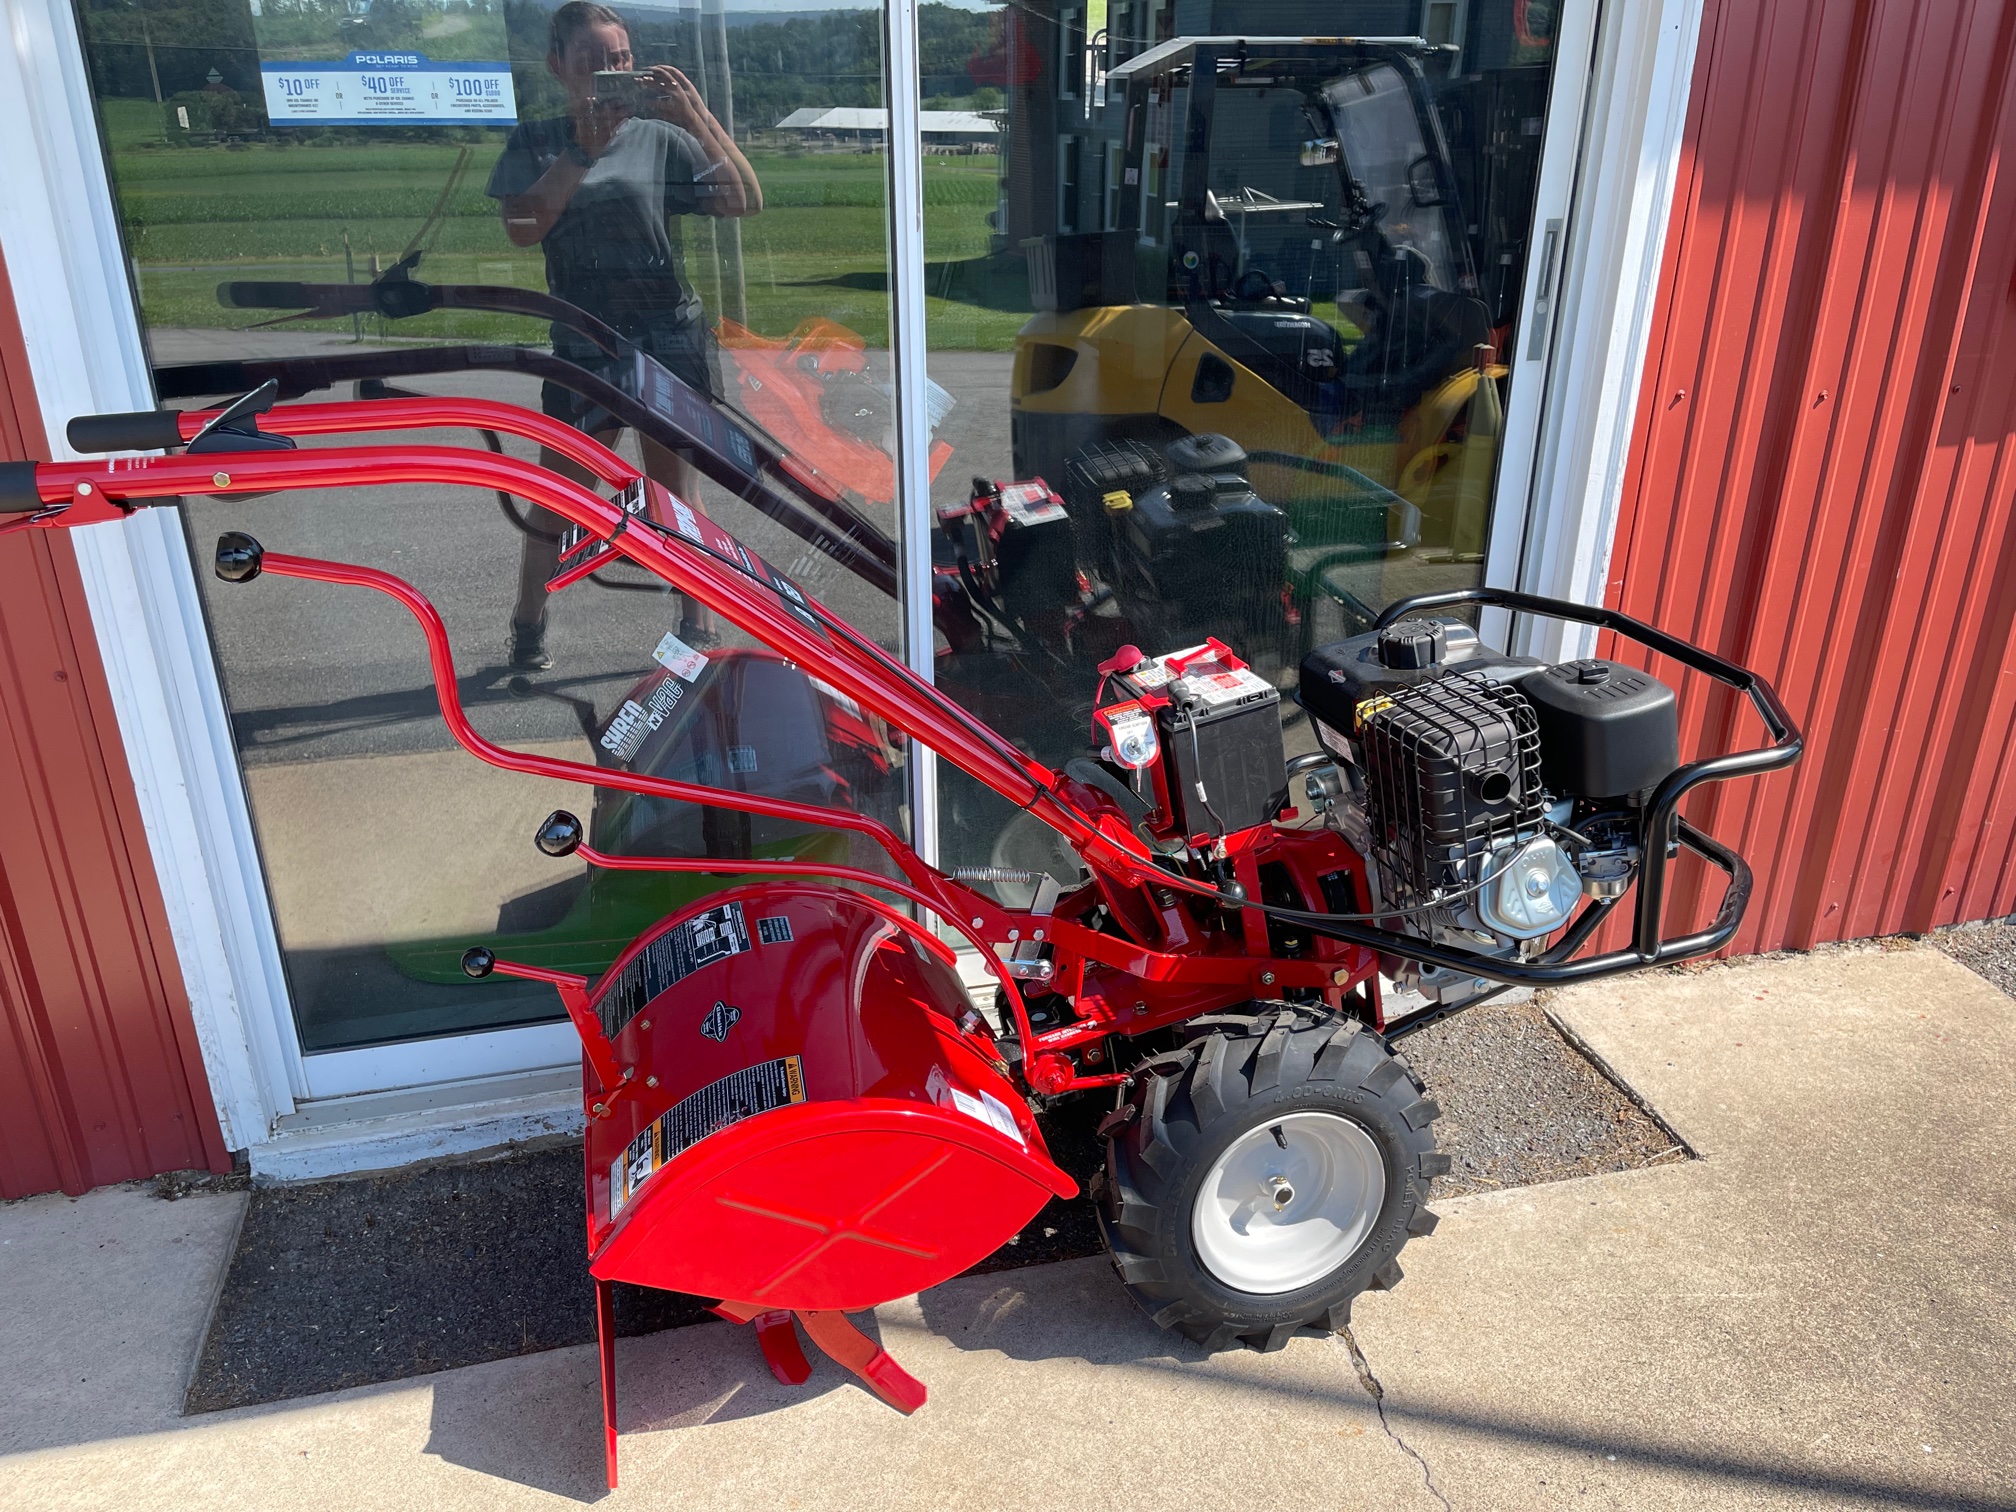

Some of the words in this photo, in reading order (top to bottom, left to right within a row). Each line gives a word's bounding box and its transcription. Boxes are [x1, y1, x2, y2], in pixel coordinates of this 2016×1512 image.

[356, 56, 418, 64] POLARIS
[278, 77, 303, 96] $10
[304, 78, 320, 89] OFF
[361, 75, 387, 94] $40
[389, 76, 404, 87] OFF
[449, 77, 482, 96] $100
[484, 79, 499, 90] OFF
[789, 1068, 801, 1095] WARNING
[1402, 1164, 1417, 1208] POWER
[1382, 1216, 1404, 1253] TRAC
